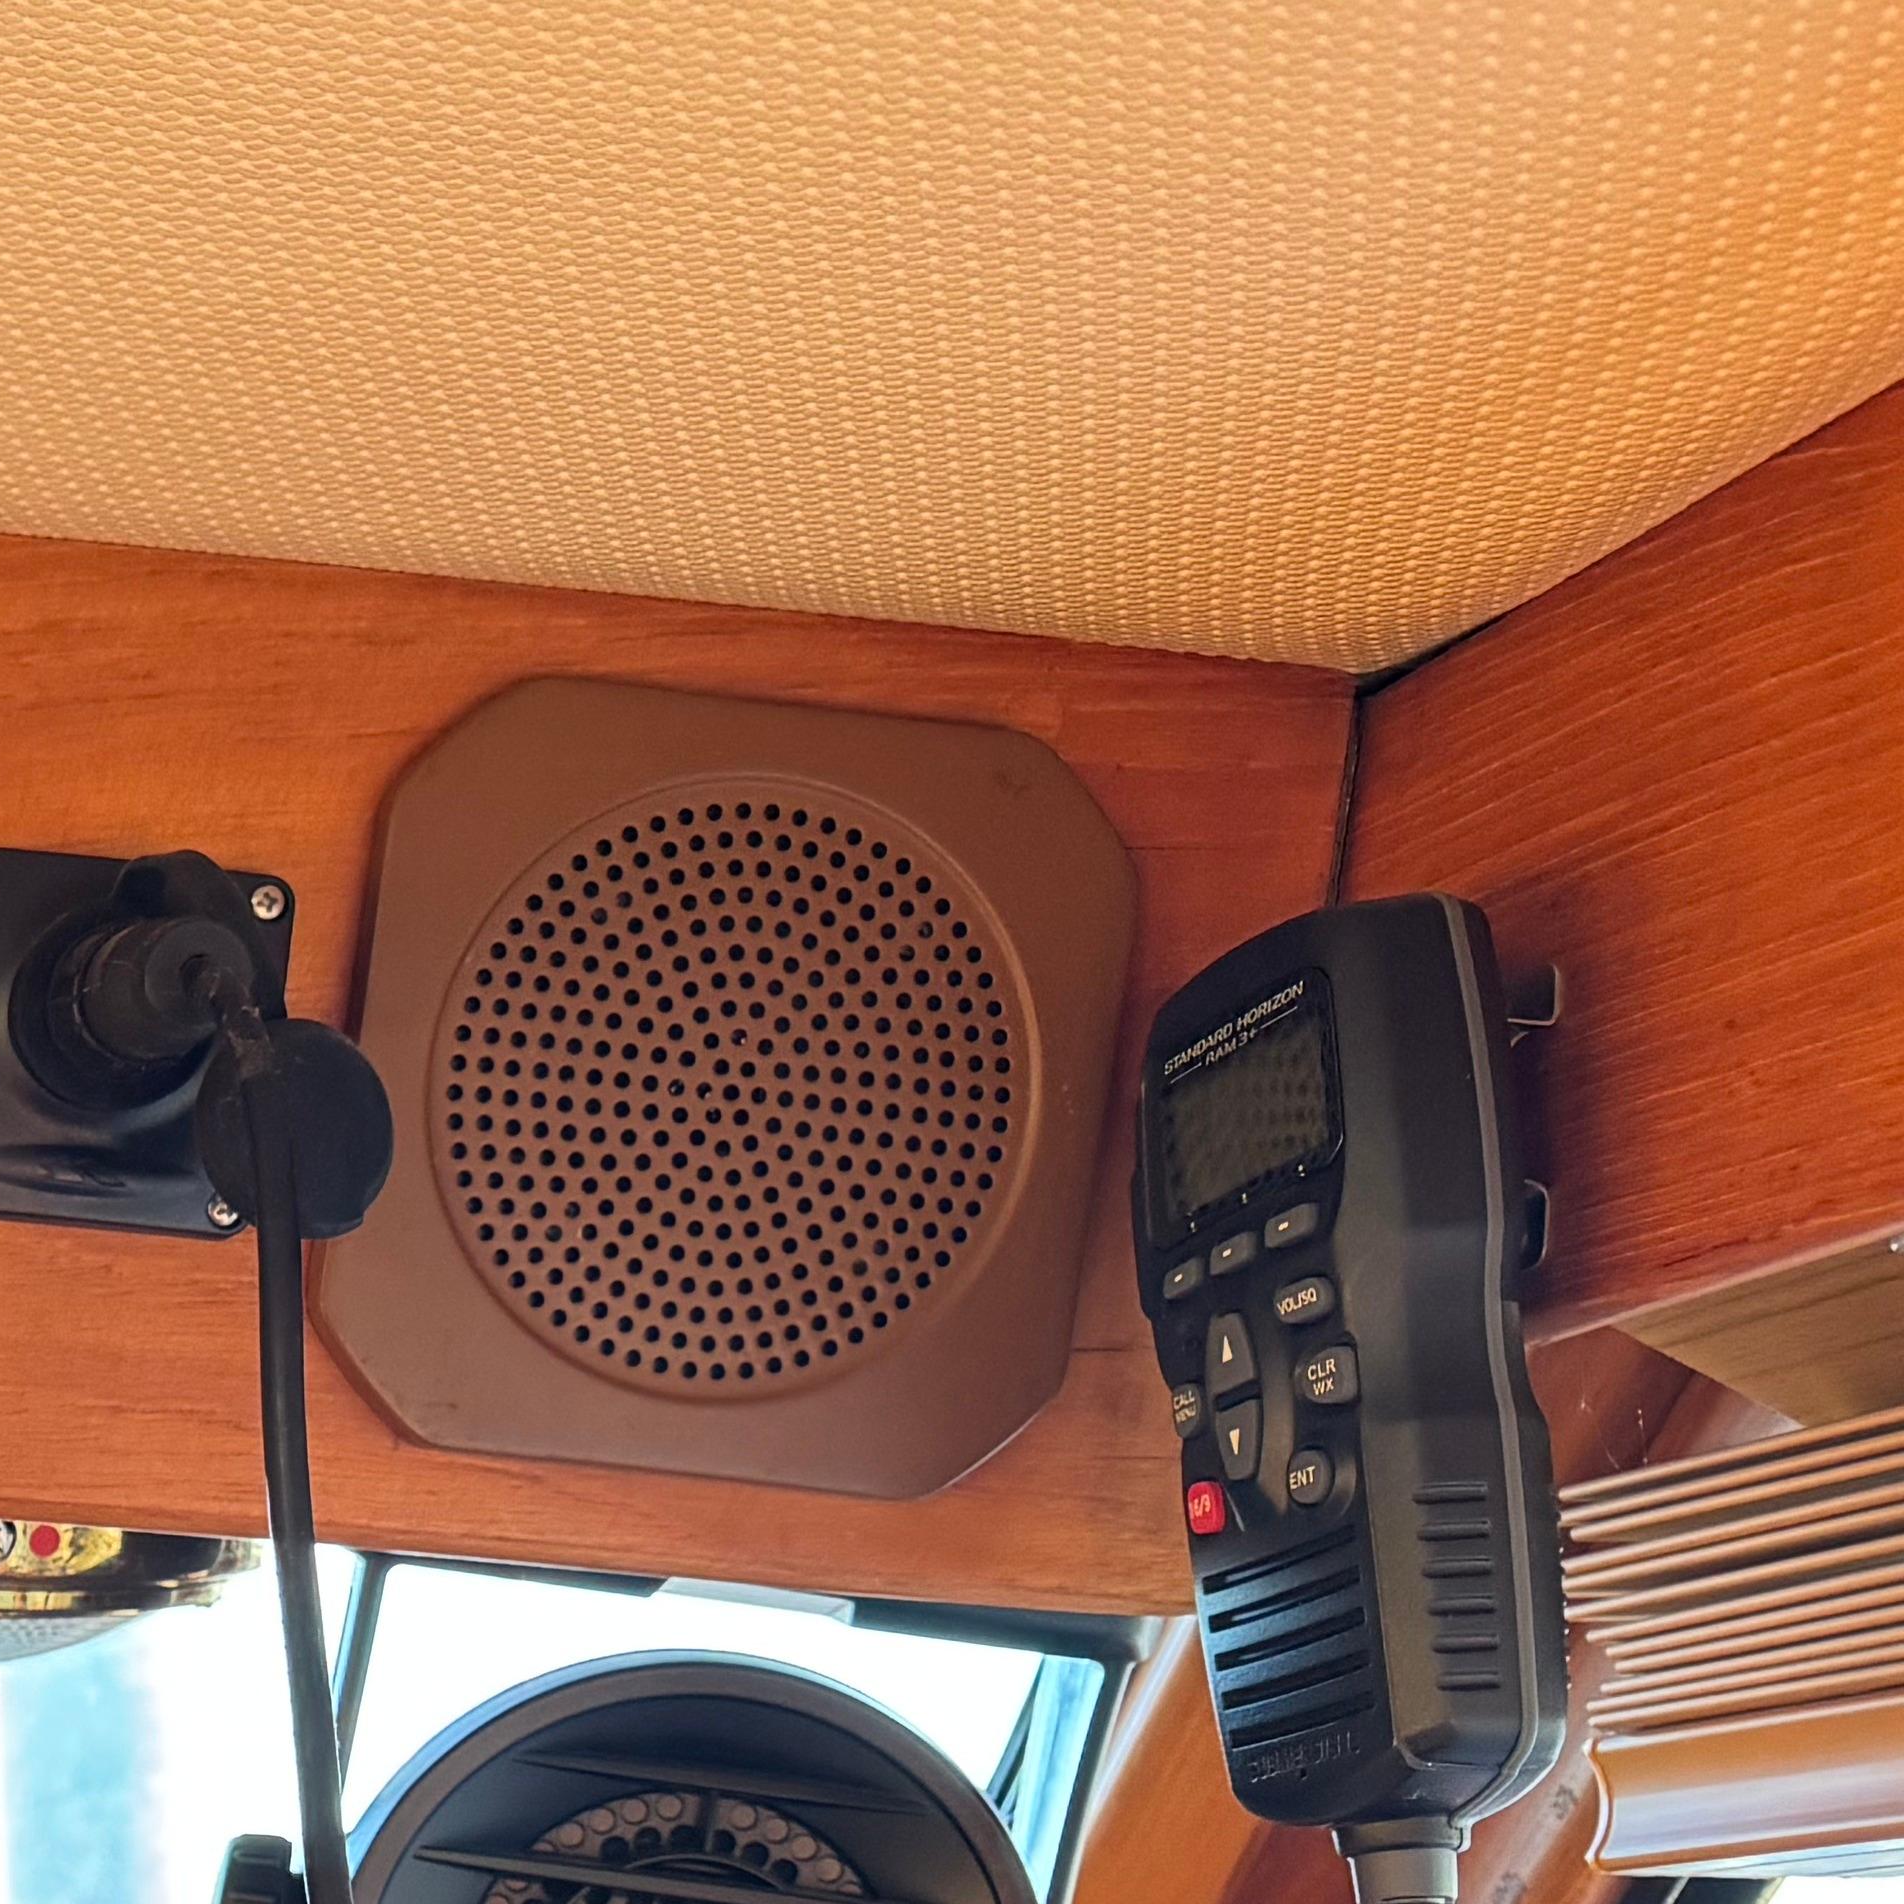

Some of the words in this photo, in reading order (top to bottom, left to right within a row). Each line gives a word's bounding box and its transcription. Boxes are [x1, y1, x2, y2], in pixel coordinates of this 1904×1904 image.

[1164, 1022, 1233, 1076] STANDARD
[1236, 980, 1304, 1031] HORIZON
[1277, 1287, 1318, 1316] VOL/SQ
[1307, 1358, 1337, 1381] CLR
[1313, 1376, 1335, 1397] WX
[1173, 1390, 1195, 1410] CALL
[1289, 1465, 1317, 1490] ENT
